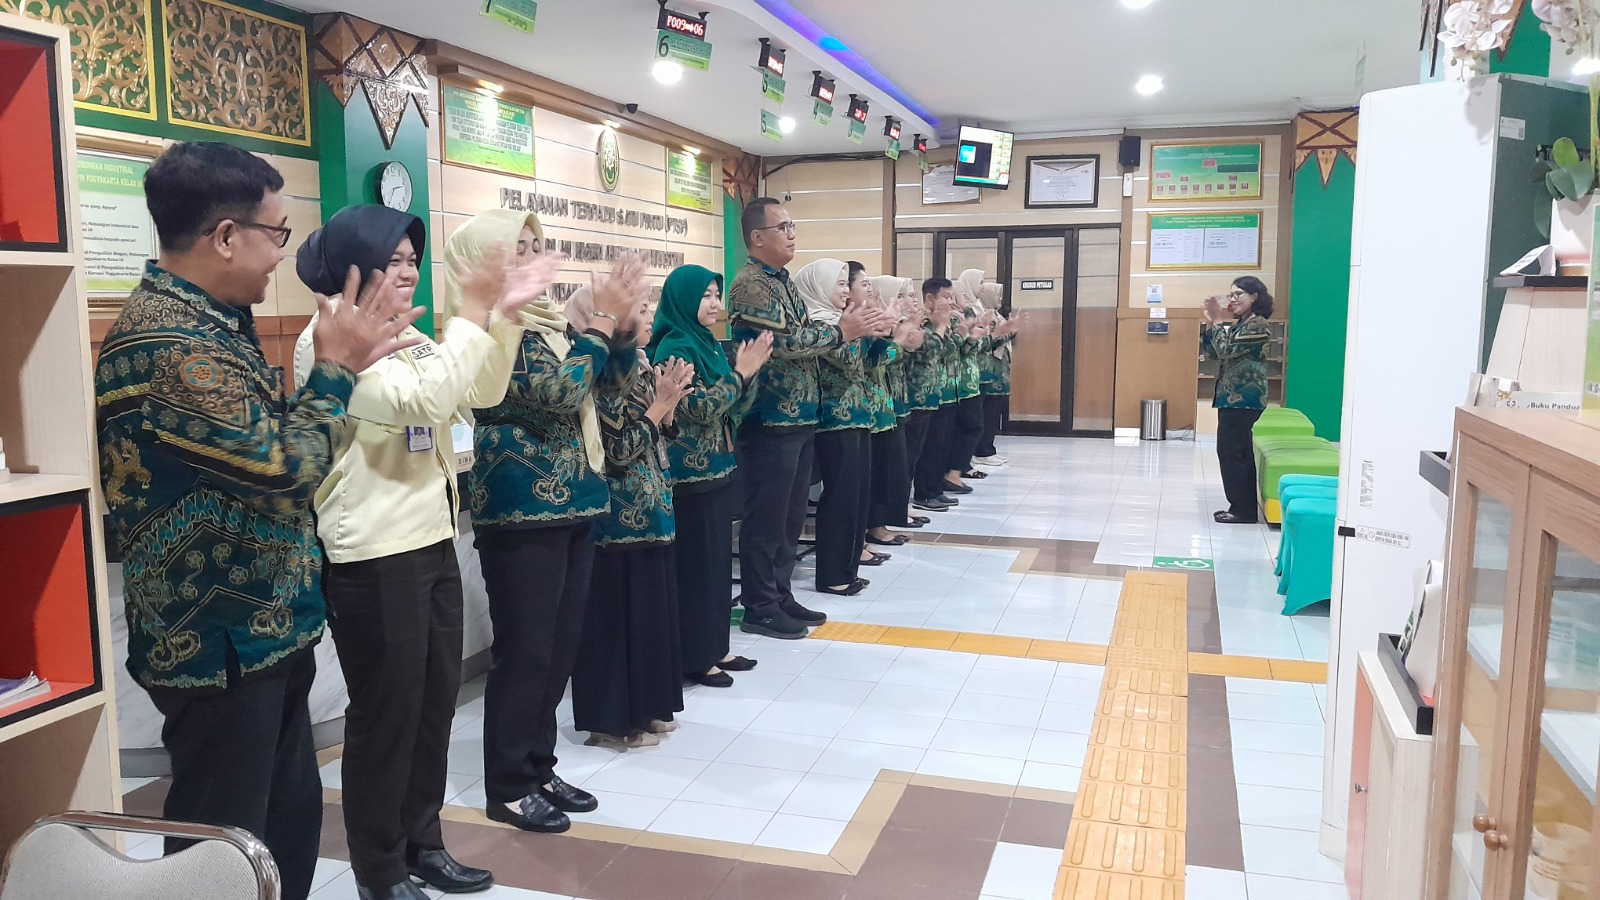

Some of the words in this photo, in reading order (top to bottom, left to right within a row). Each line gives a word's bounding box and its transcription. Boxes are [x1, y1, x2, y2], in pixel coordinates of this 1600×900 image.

[658, 35, 670, 58] 6
[500, 187, 569, 217] PELAYANAN
[411, 345, 432, 358] SATP
[1530, 401, 1550, 410] Buku
